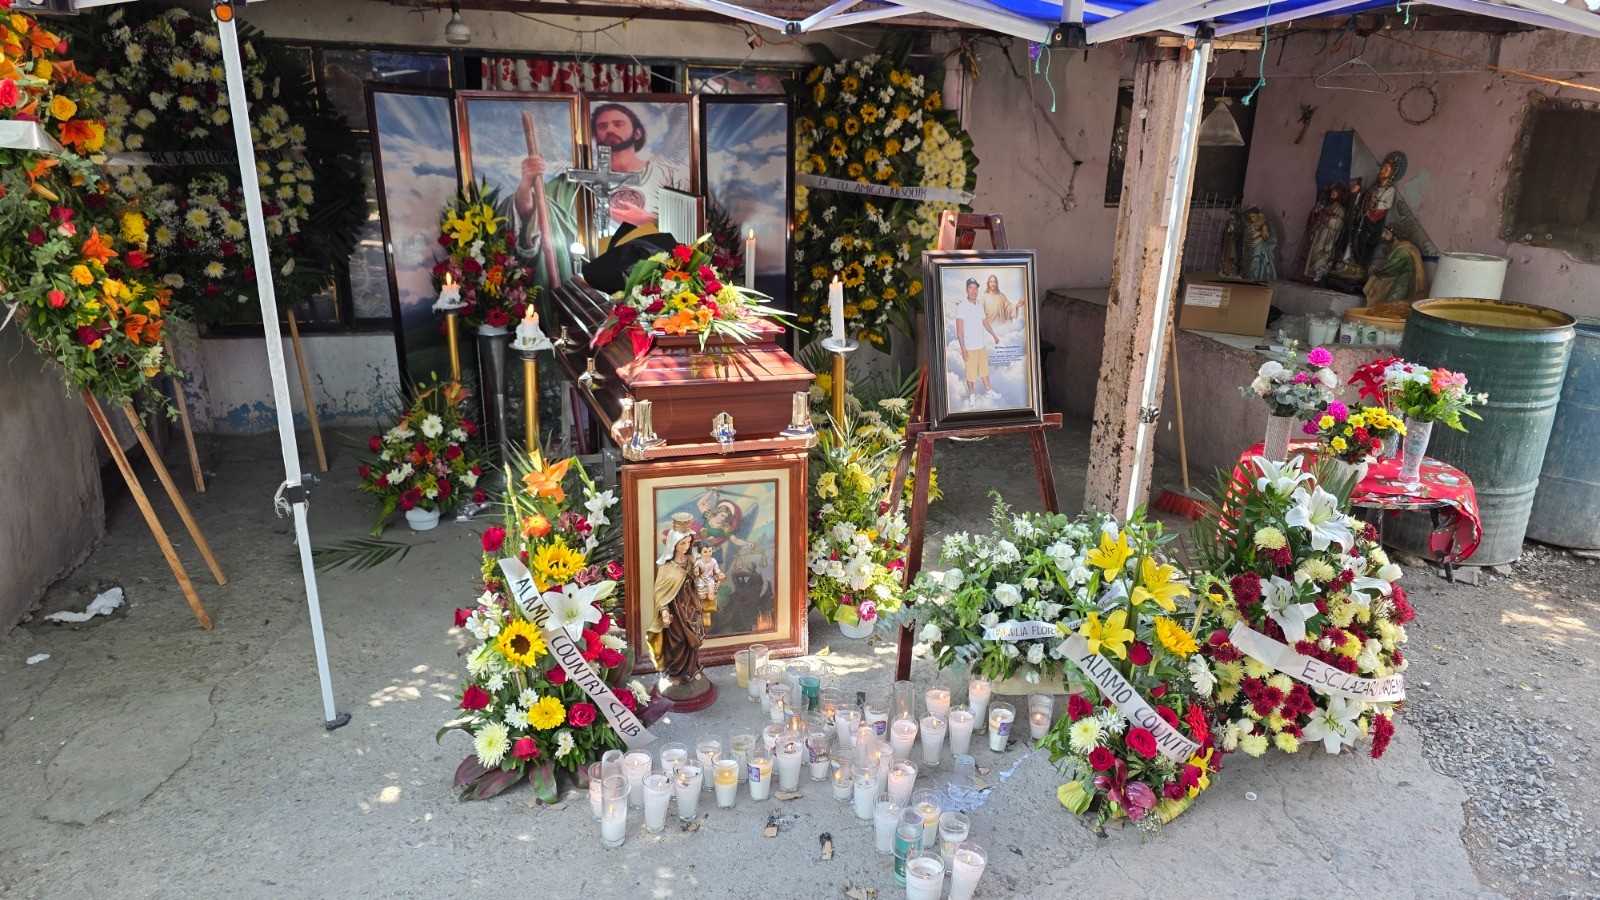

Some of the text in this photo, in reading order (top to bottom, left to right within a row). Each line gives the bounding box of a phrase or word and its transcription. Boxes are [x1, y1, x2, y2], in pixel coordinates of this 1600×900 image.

[207, 150, 238, 164] COMP
[819, 178, 828, 188] DE
[837, 181, 848, 191] TU
[995, 625, 1056, 637] FAMILIA FLOR
[1080, 653, 1133, 704] ALAMO
[1301, 660, 1341, 689] ESC.
[551, 635, 608, 696] COUNTRY
[609, 702, 641, 737] CLUB
